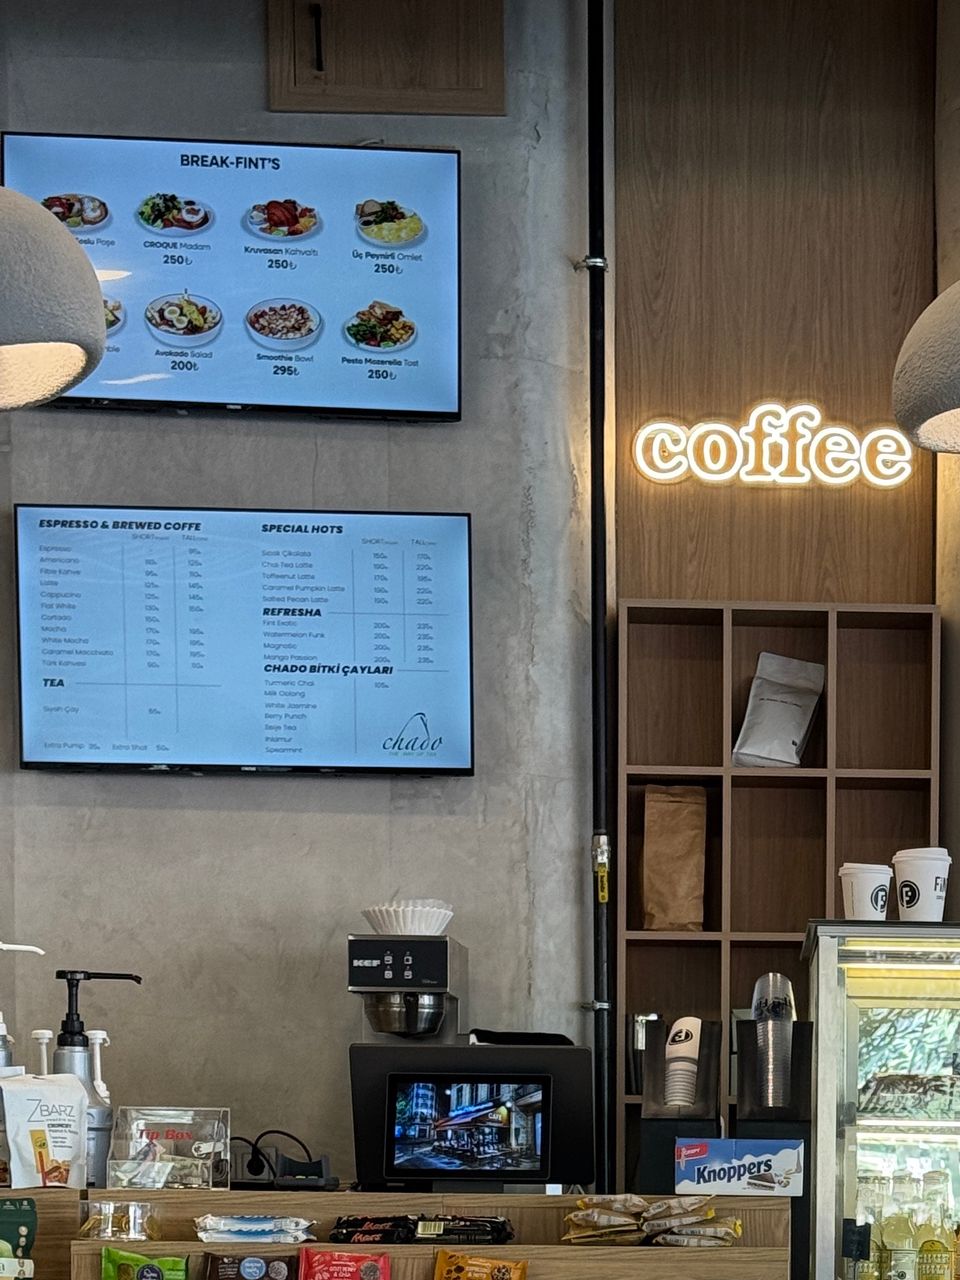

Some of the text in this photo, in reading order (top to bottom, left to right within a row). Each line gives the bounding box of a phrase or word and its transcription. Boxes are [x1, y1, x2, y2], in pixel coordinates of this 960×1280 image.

[180, 154, 281, 171] BREAK-FINT'S
[144, 240, 211, 251] CROQUE Madam
[244, 246, 283, 256] Kruvasan
[365, 251, 396, 261] Peynirli
[397, 252, 423, 262] Omlet
[155, 349, 213, 359] Avokado Salad
[256, 353, 314, 363] Smoothie Bowl
[342, 356, 363, 365] Pesto
[635, 402, 912, 487] coffee
[39, 520, 202, 531] ESPRESSO & BREWED COFFE
[262, 524, 344, 534] SPECIAL HOTS
[262, 584, 293, 592] Caramel
[295, 584, 325, 592] Pumpkin
[262, 608, 322, 617] REFRESHA
[264, 654, 289, 662] Mango
[264, 664, 307, 674] CHADO
[342, 666, 394, 676] ÇAYLARI
[42, 678, 65, 688] TEA
[138, 1128, 193, 1141] Tip Box
[696, 1159, 772, 1185] Knoppers
